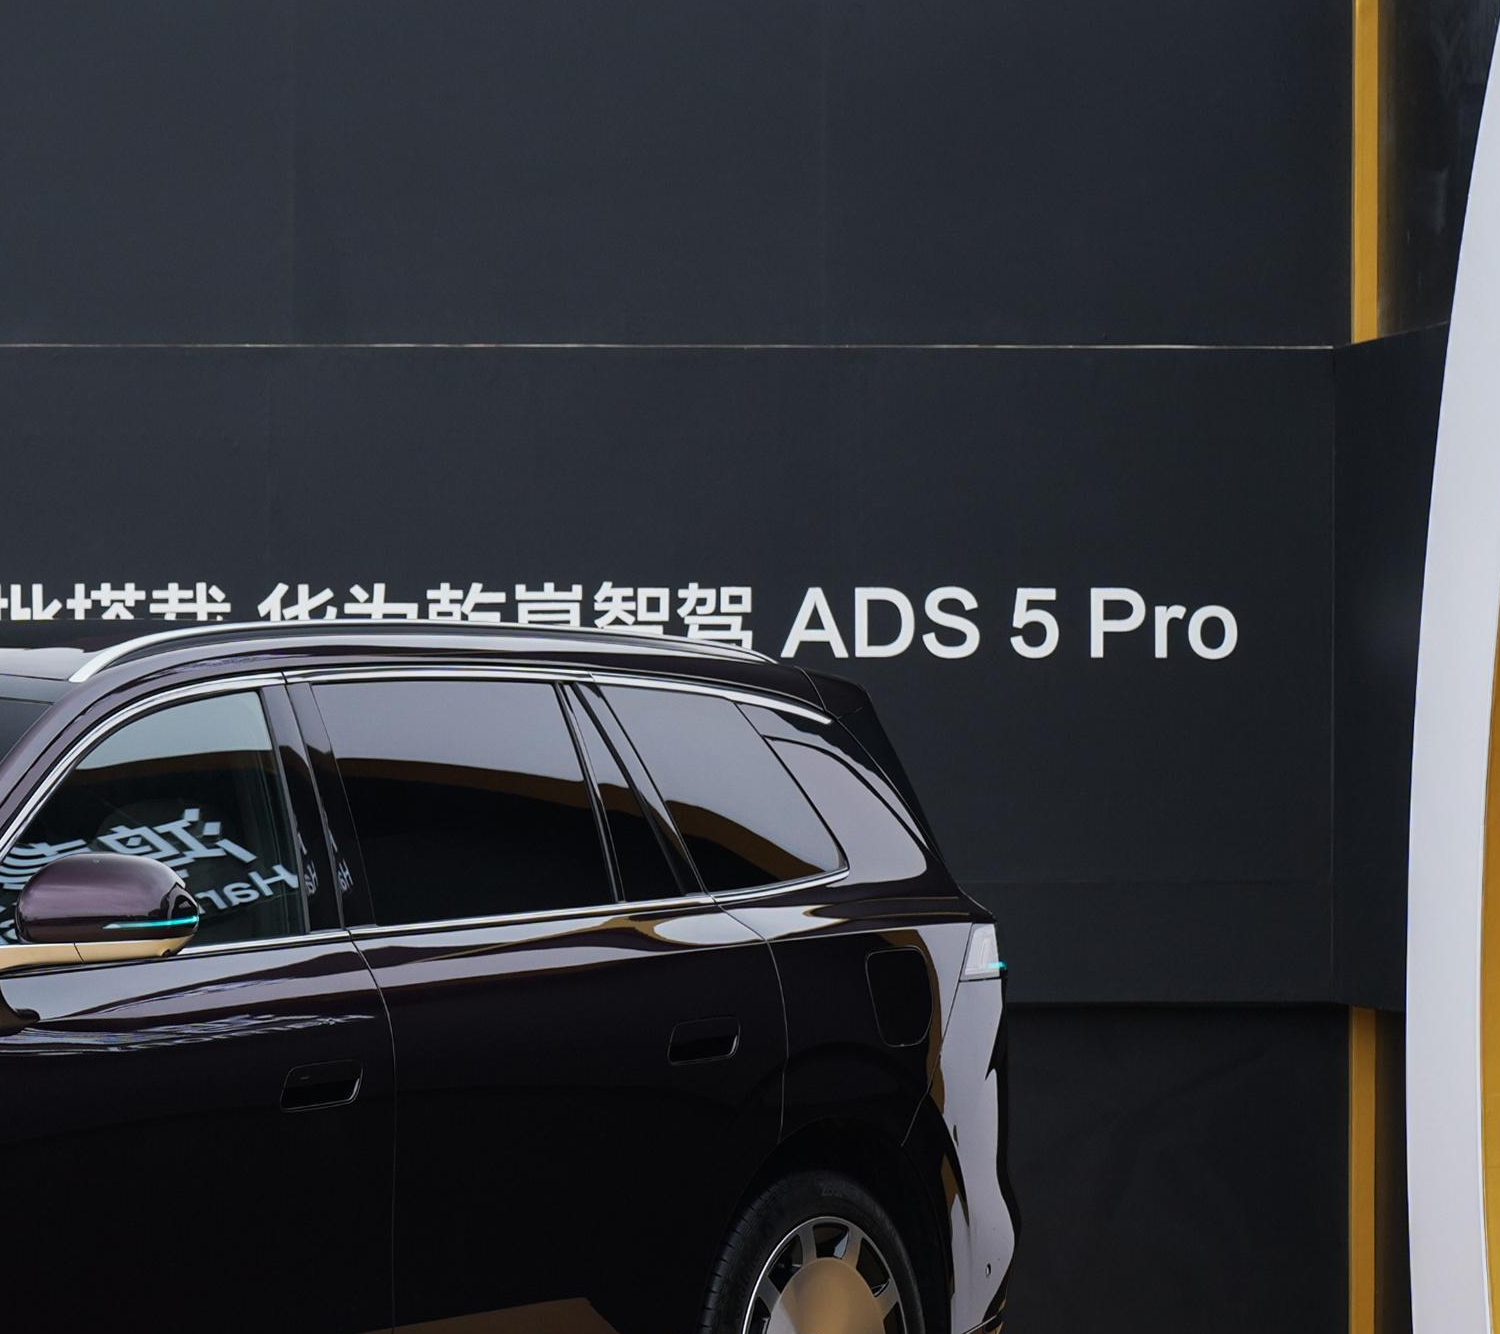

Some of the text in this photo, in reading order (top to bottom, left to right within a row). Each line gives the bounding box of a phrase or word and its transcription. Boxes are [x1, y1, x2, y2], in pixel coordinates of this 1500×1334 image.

[779, 585, 981, 660] ADS
[1009, 587, 1060, 660] 5
[1090, 587, 1239, 660] Pro
